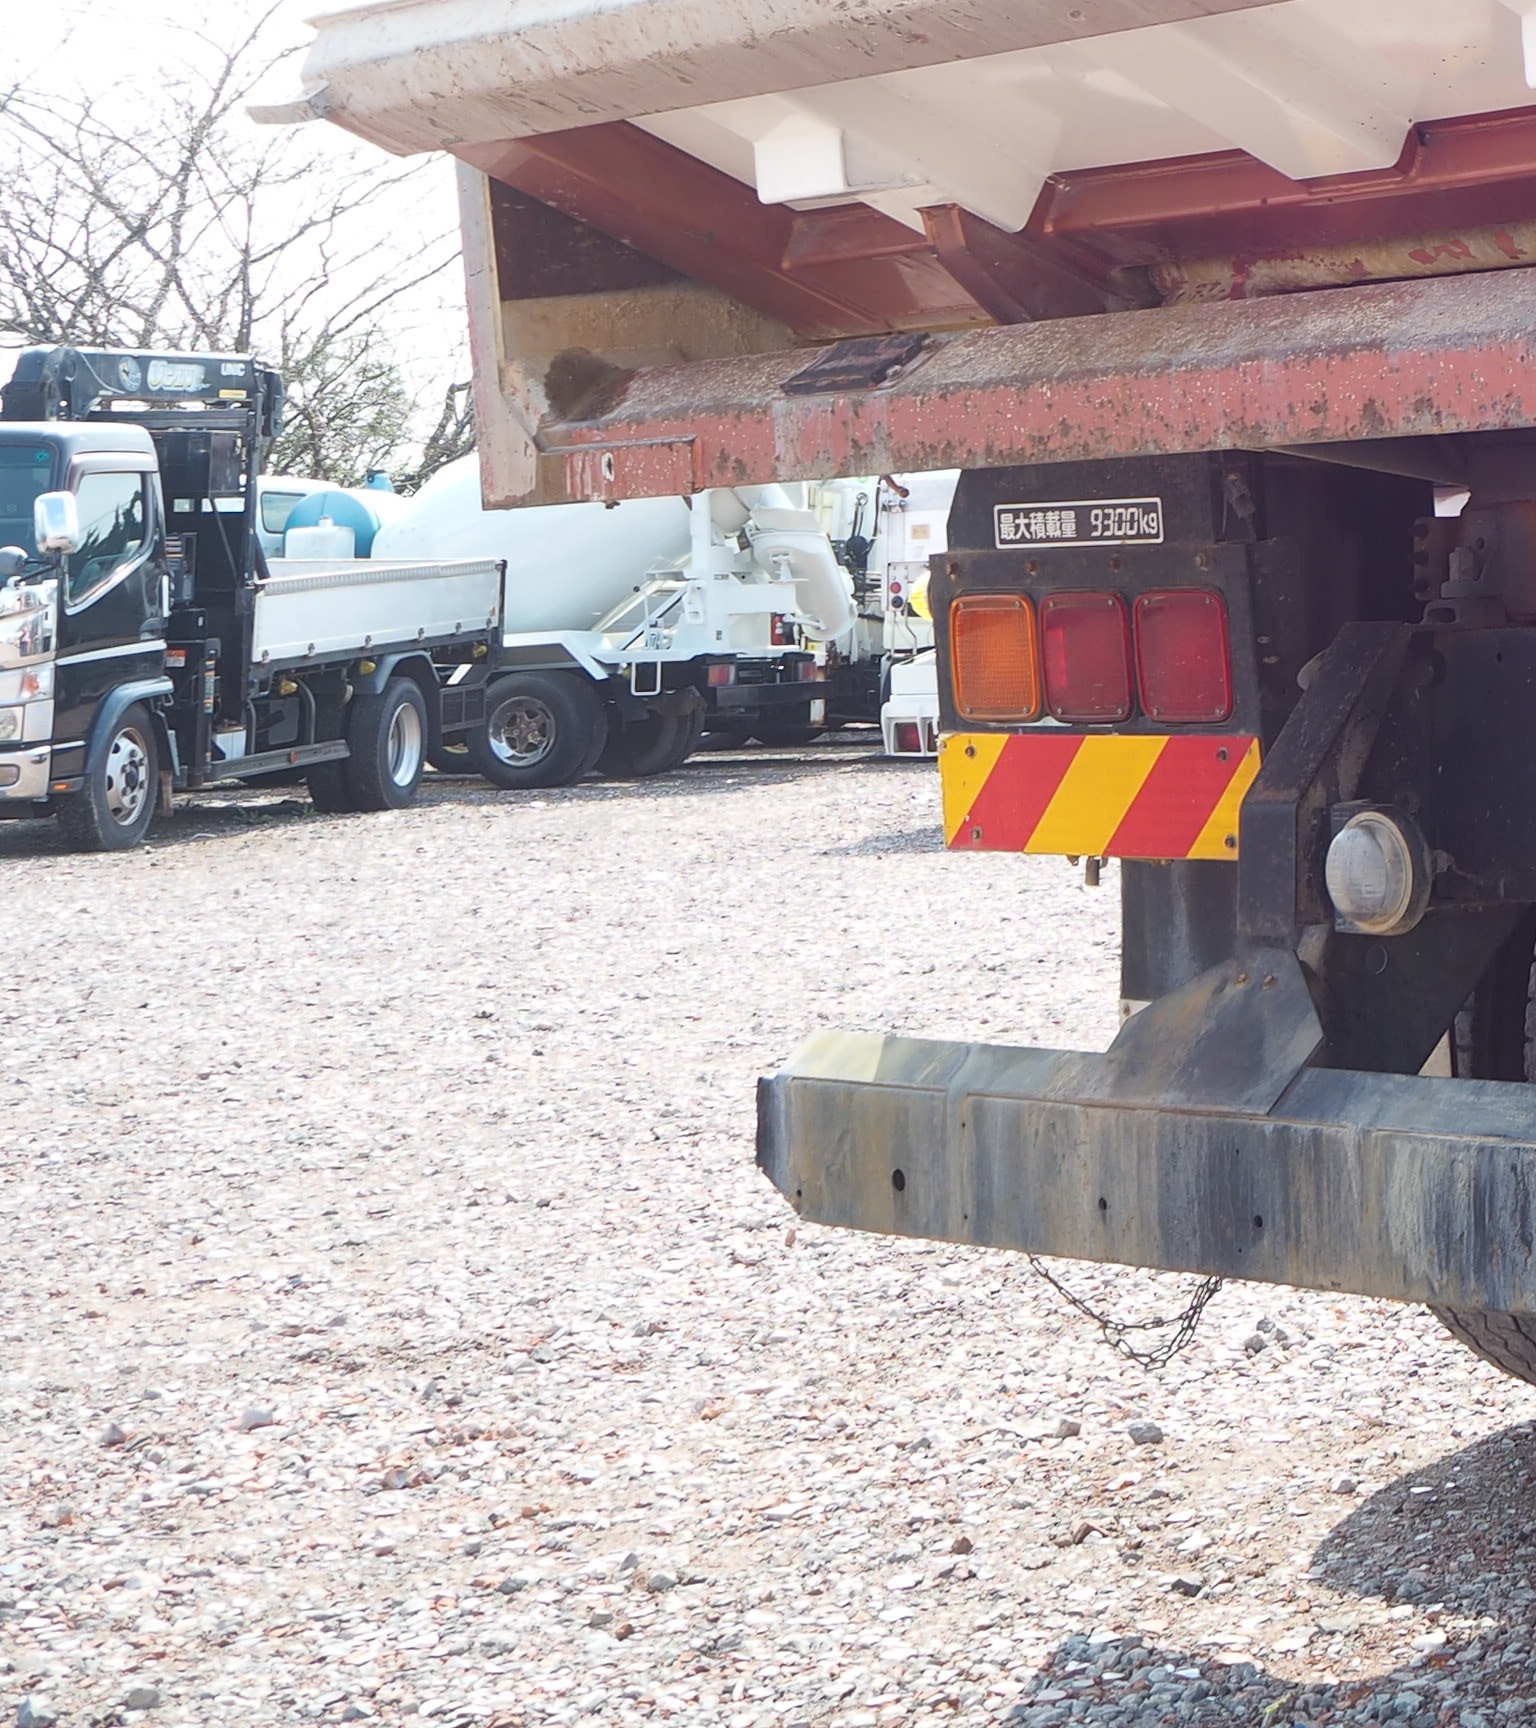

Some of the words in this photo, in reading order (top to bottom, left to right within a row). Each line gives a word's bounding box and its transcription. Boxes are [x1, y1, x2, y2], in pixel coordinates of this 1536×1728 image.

[999, 510, 1077, 540] 最大積載量
[1090, 507, 1158, 537] 9300kg
